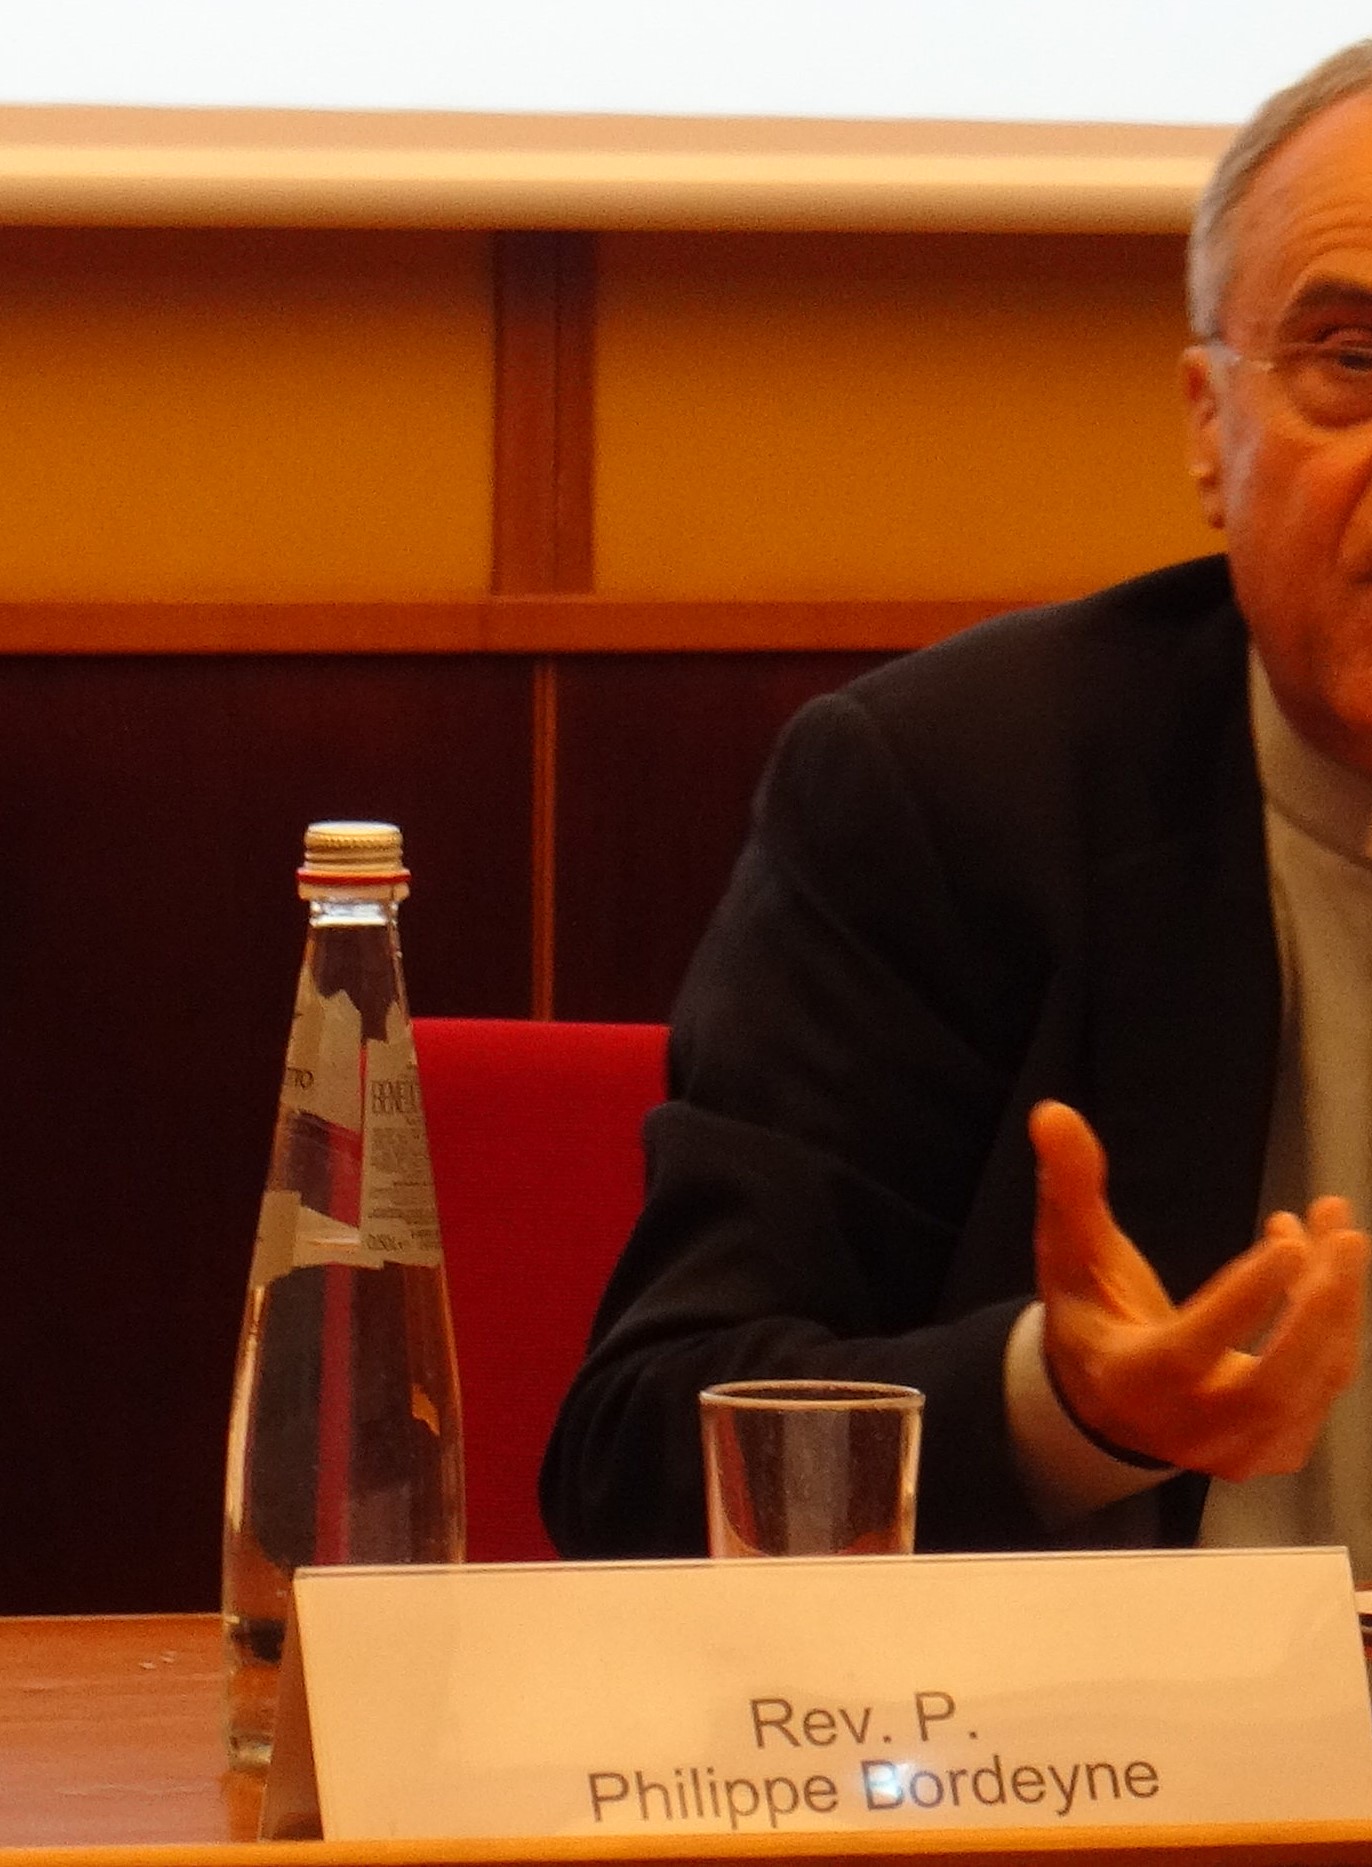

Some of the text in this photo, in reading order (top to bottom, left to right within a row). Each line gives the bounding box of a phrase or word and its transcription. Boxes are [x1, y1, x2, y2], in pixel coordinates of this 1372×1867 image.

[750, 1691, 979, 1748] Rev. P.
[587, 1755, 1160, 1830] Philippe Bordeyne
